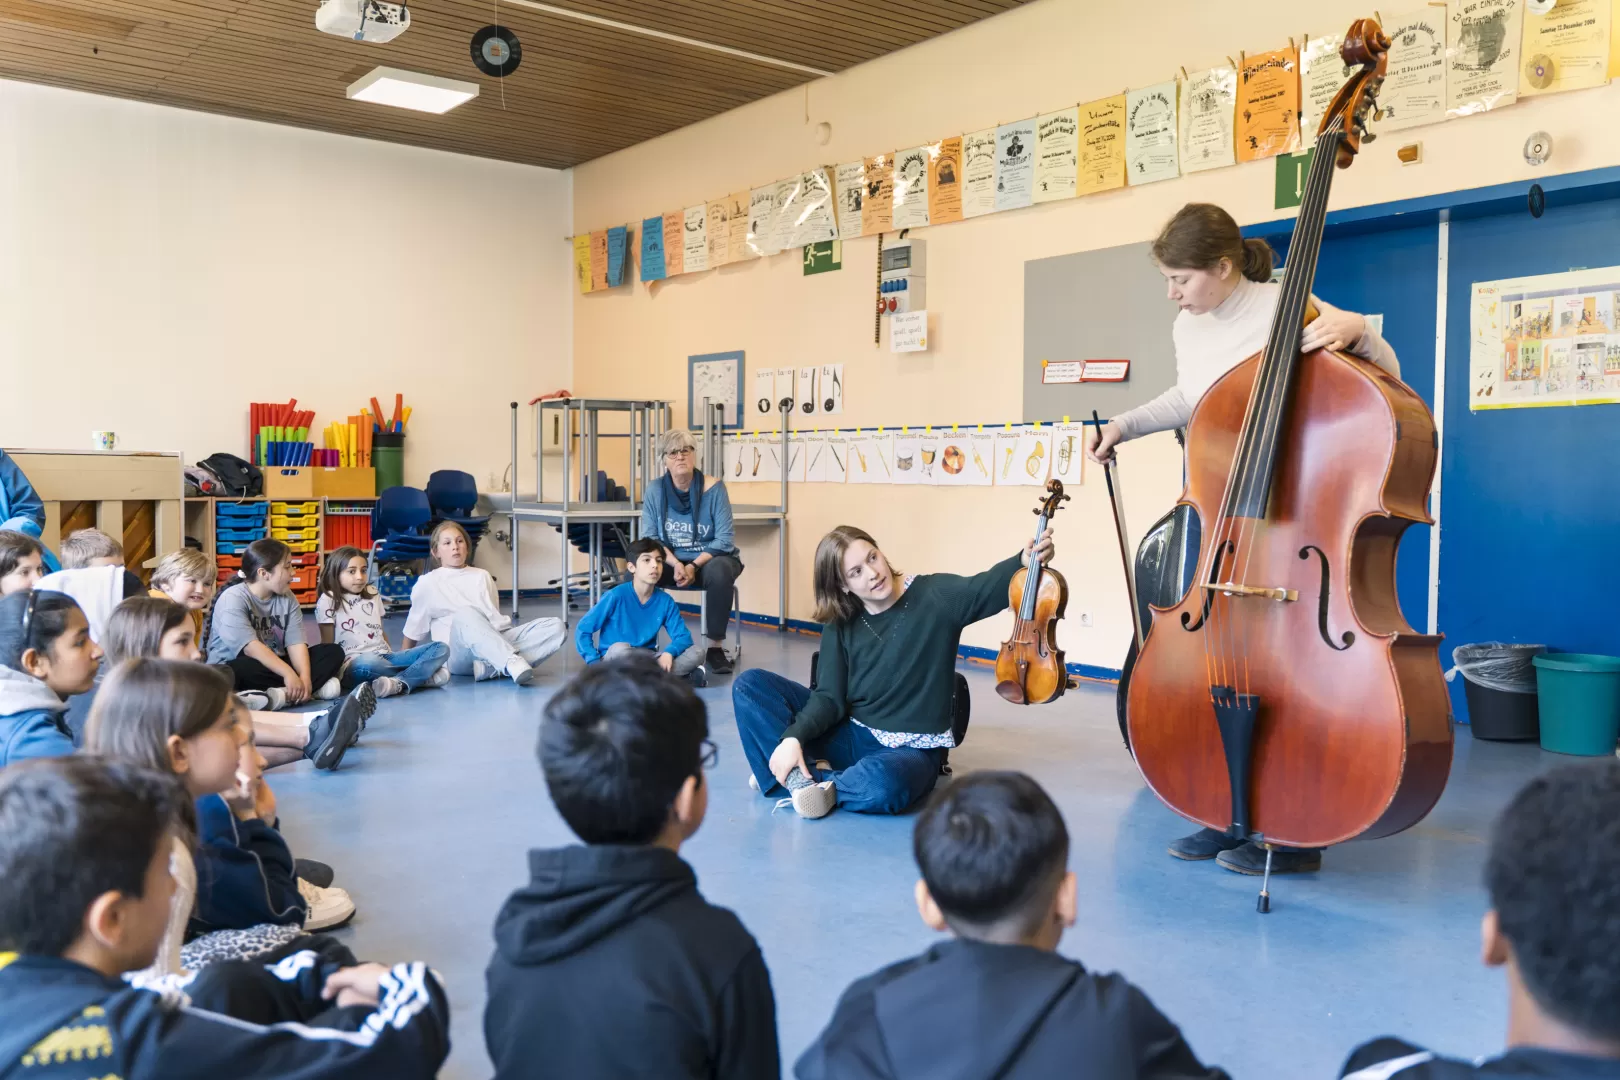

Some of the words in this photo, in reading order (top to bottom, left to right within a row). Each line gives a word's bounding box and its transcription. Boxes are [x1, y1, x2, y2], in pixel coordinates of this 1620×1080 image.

[1464, 4, 1477, 14] WAR
[1408, 21, 1418, 32] mal
[801, 368, 808, 378] ta
